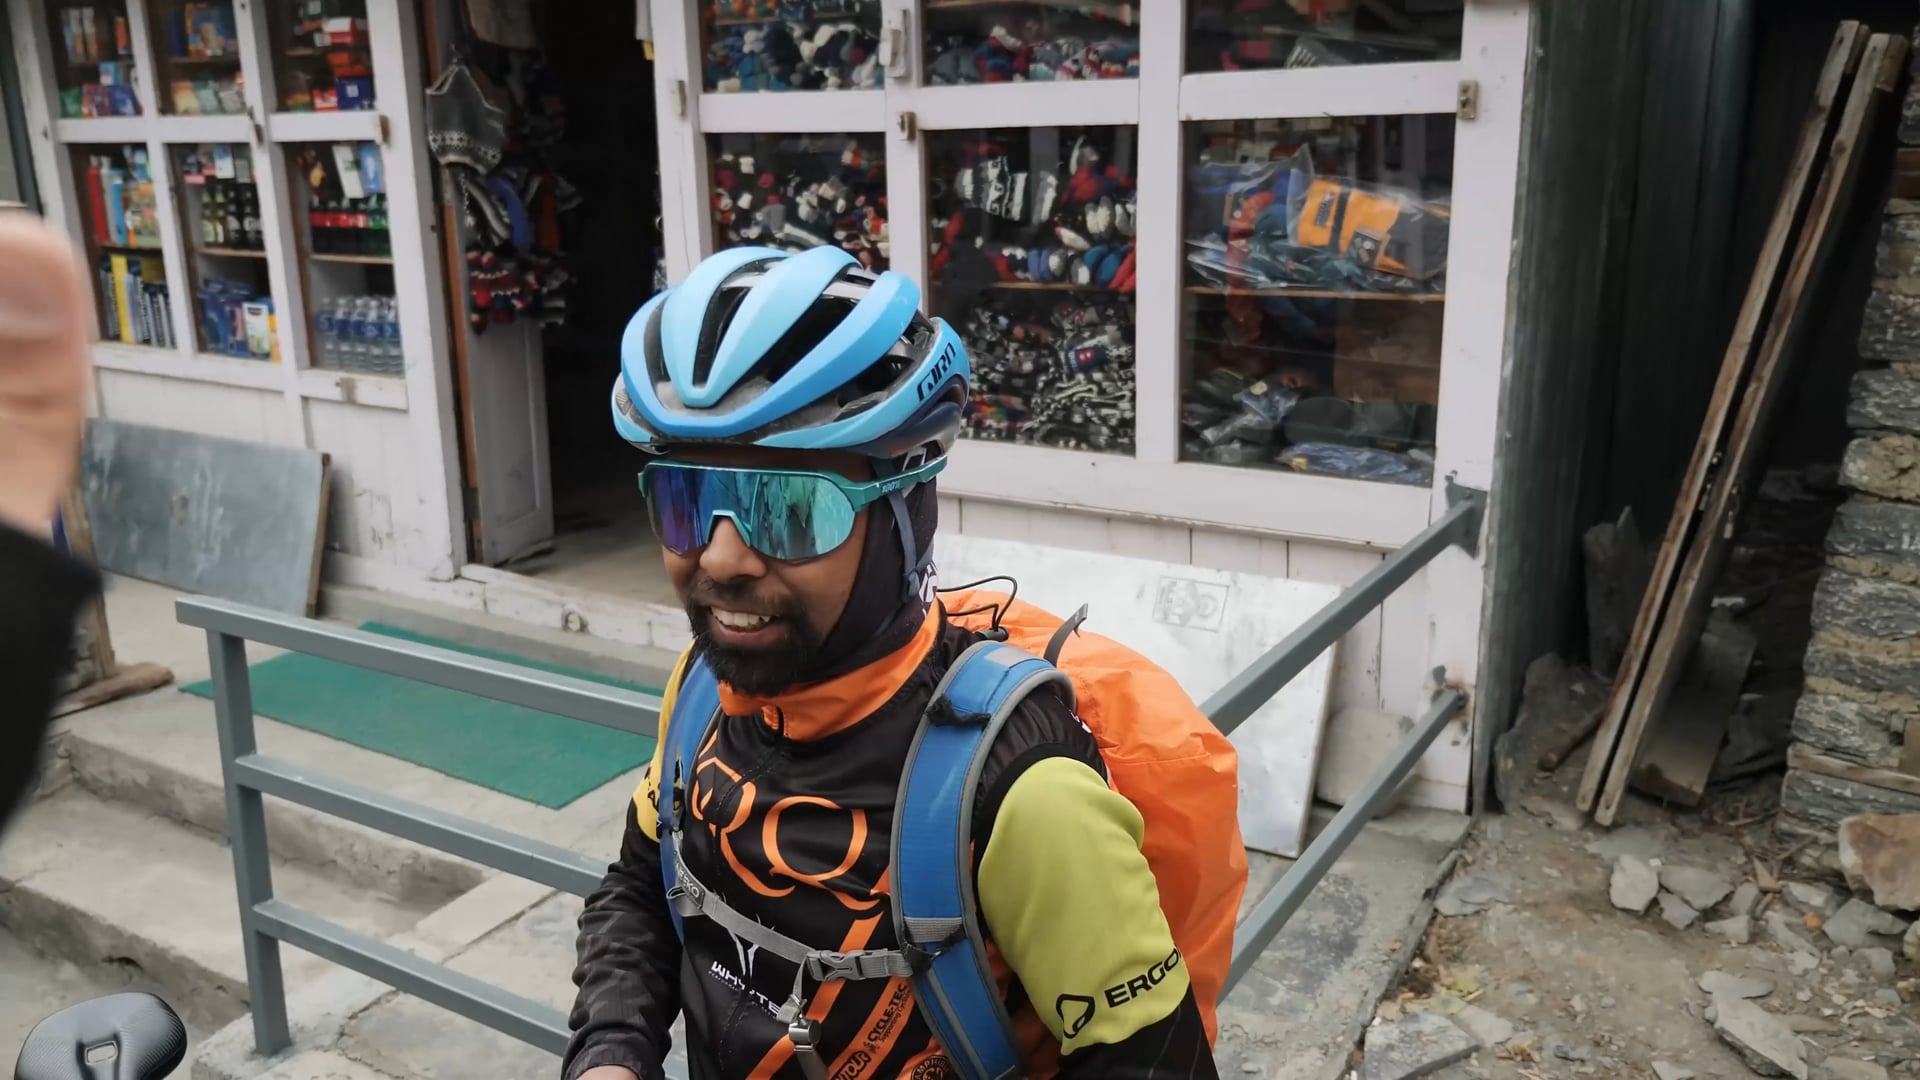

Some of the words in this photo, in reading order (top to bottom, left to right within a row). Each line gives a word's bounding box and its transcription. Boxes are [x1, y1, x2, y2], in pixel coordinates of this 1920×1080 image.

[917, 342, 956, 402] GIRO
[1104, 947, 1181, 1008] ERGO
[867, 983, 907, 1042] CYCLE-TEC
